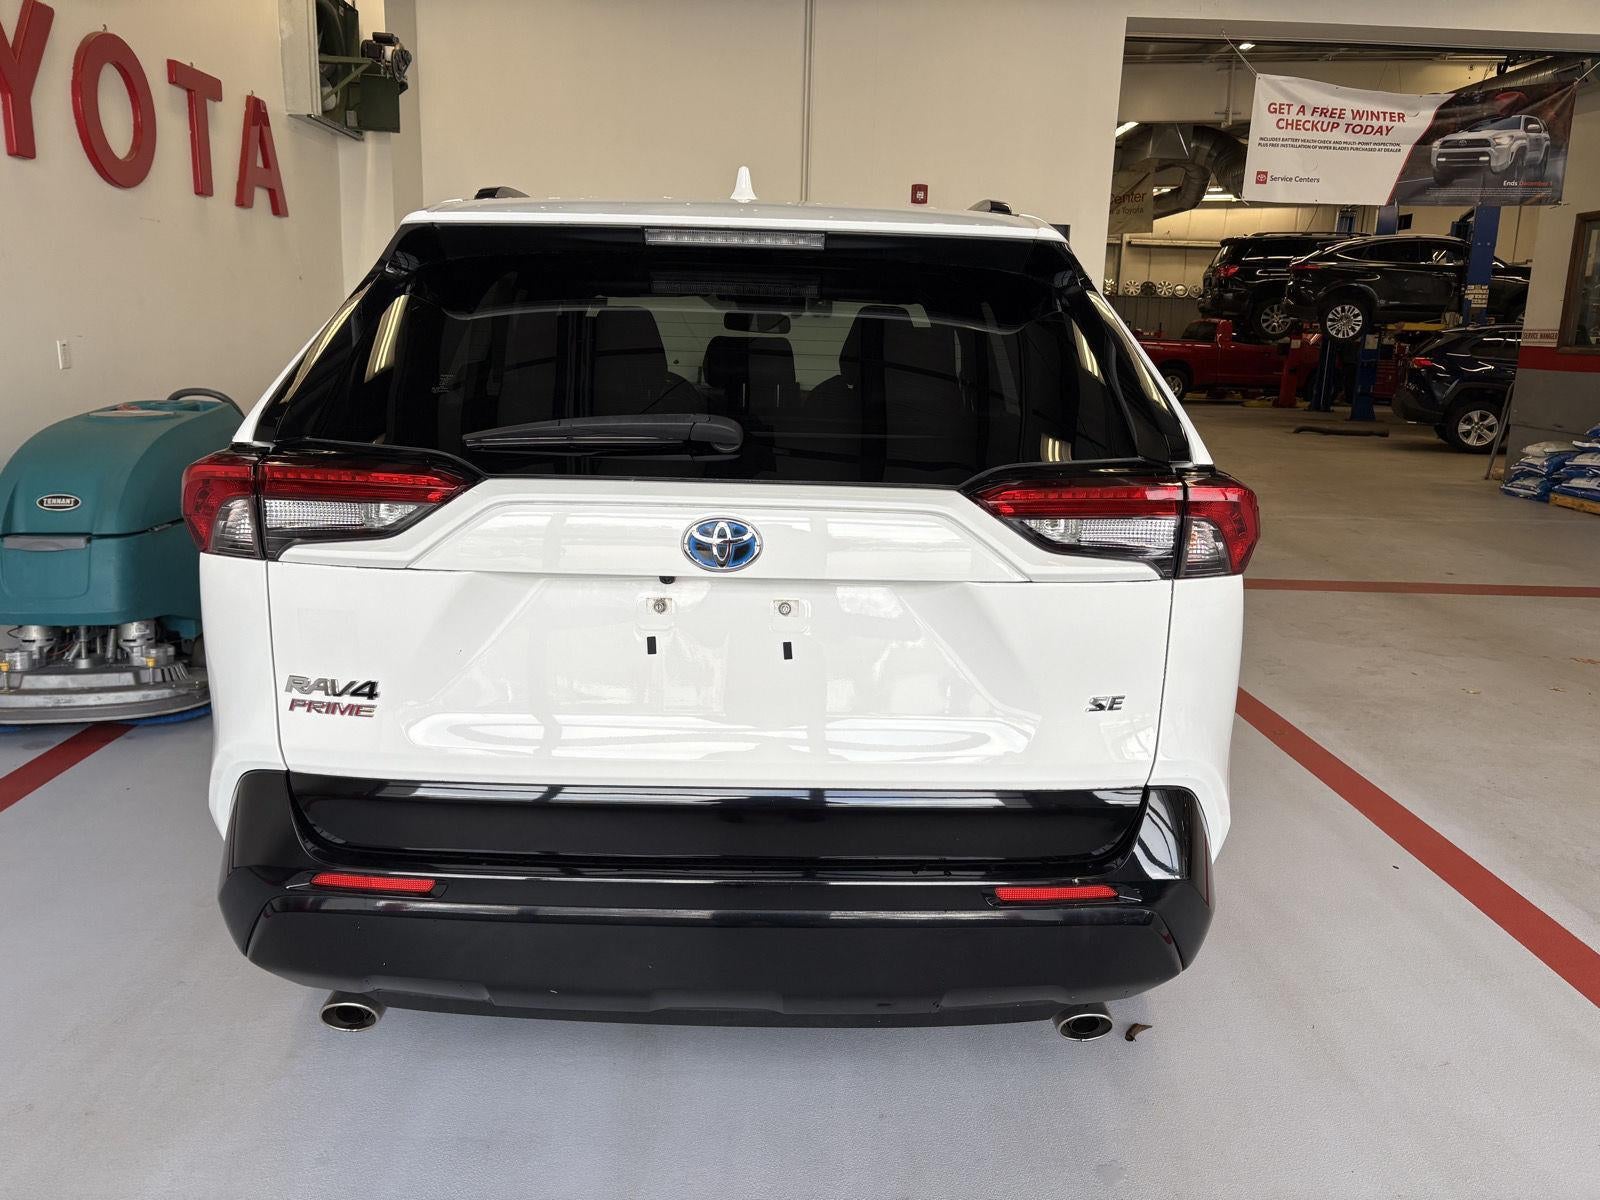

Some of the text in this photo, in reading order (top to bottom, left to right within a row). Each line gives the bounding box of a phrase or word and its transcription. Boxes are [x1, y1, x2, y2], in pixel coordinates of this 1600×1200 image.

[1267, 102, 1406, 123] GET A FREE WINTER
[1275, 118, 1394, 136] CHECKUP TODAY
[1269, 175, 1320, 184] Service Centers
[43, 497, 76, 507] TENNANT
[284, 674, 380, 701] RAV4
[288, 698, 378, 718] PRIME
[1085, 695, 1126, 712] SE
